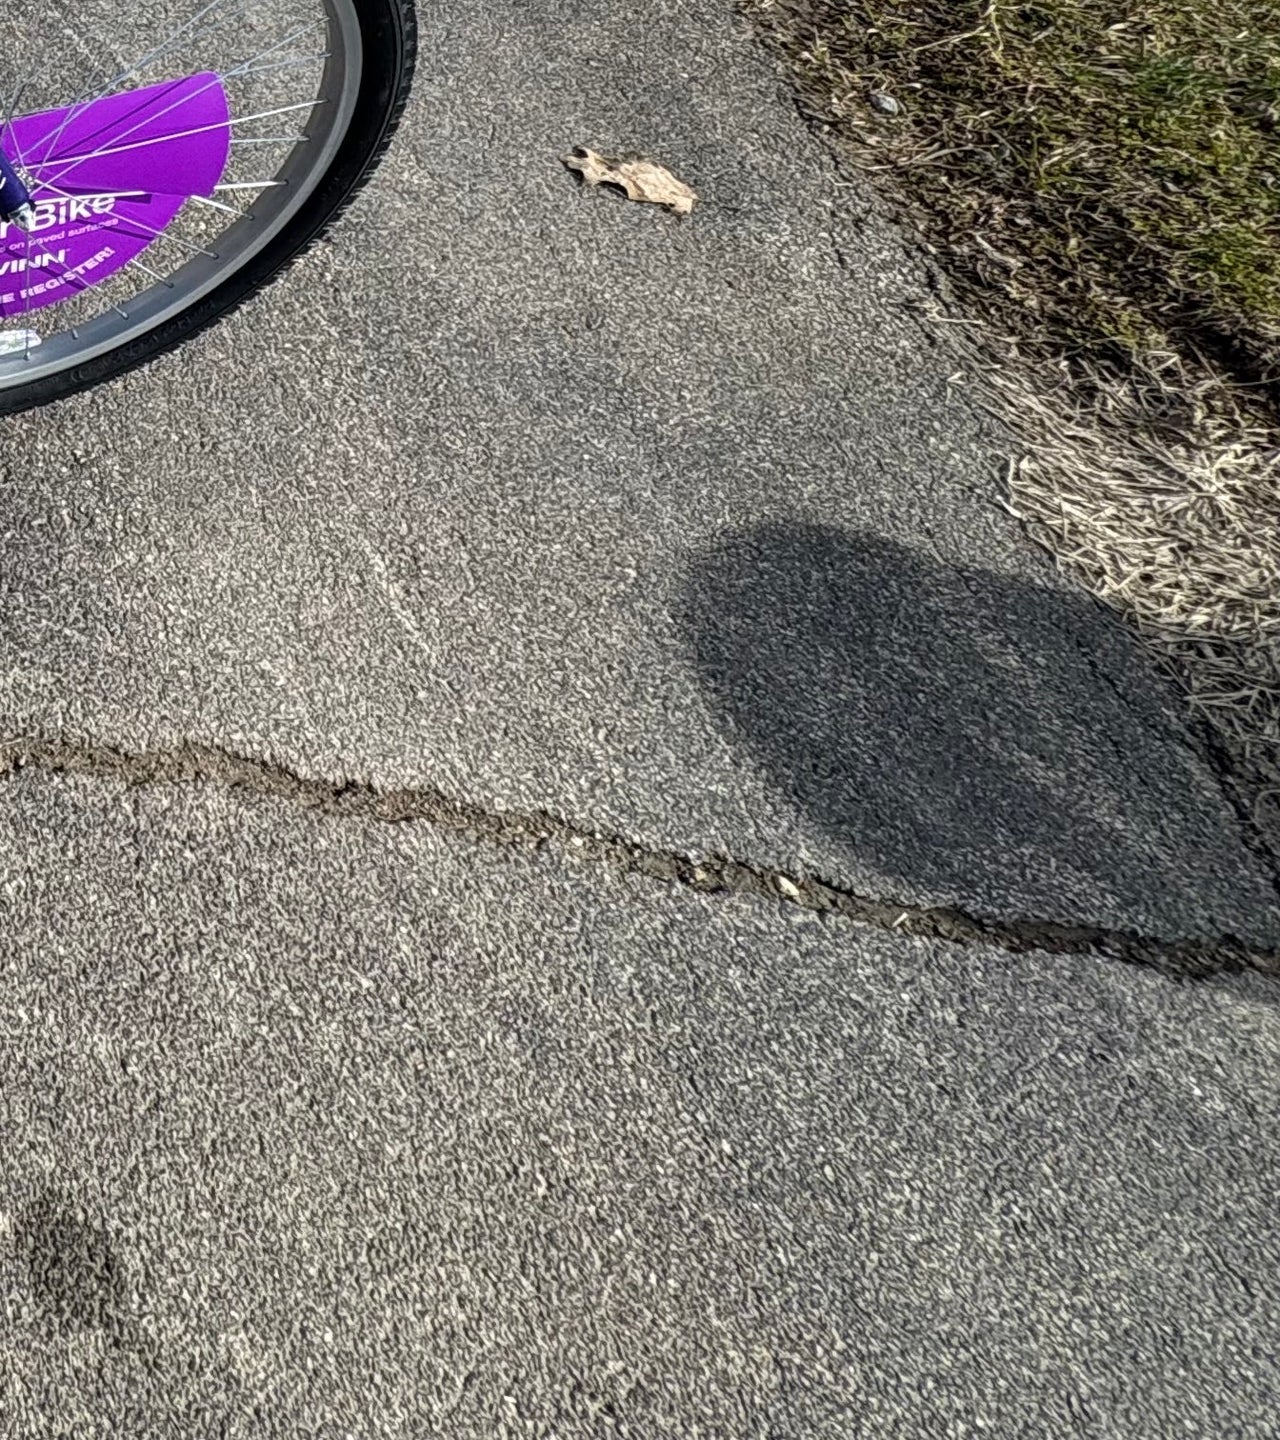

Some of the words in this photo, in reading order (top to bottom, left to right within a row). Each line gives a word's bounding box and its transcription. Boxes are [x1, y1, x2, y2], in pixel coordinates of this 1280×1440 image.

[28, 194, 116, 232] Bike
[9, 240, 26, 251] on
[28, 230, 66, 248] paved
[68, 218, 120, 237] surfaces
[20, 246, 117, 300] REGISTER!
